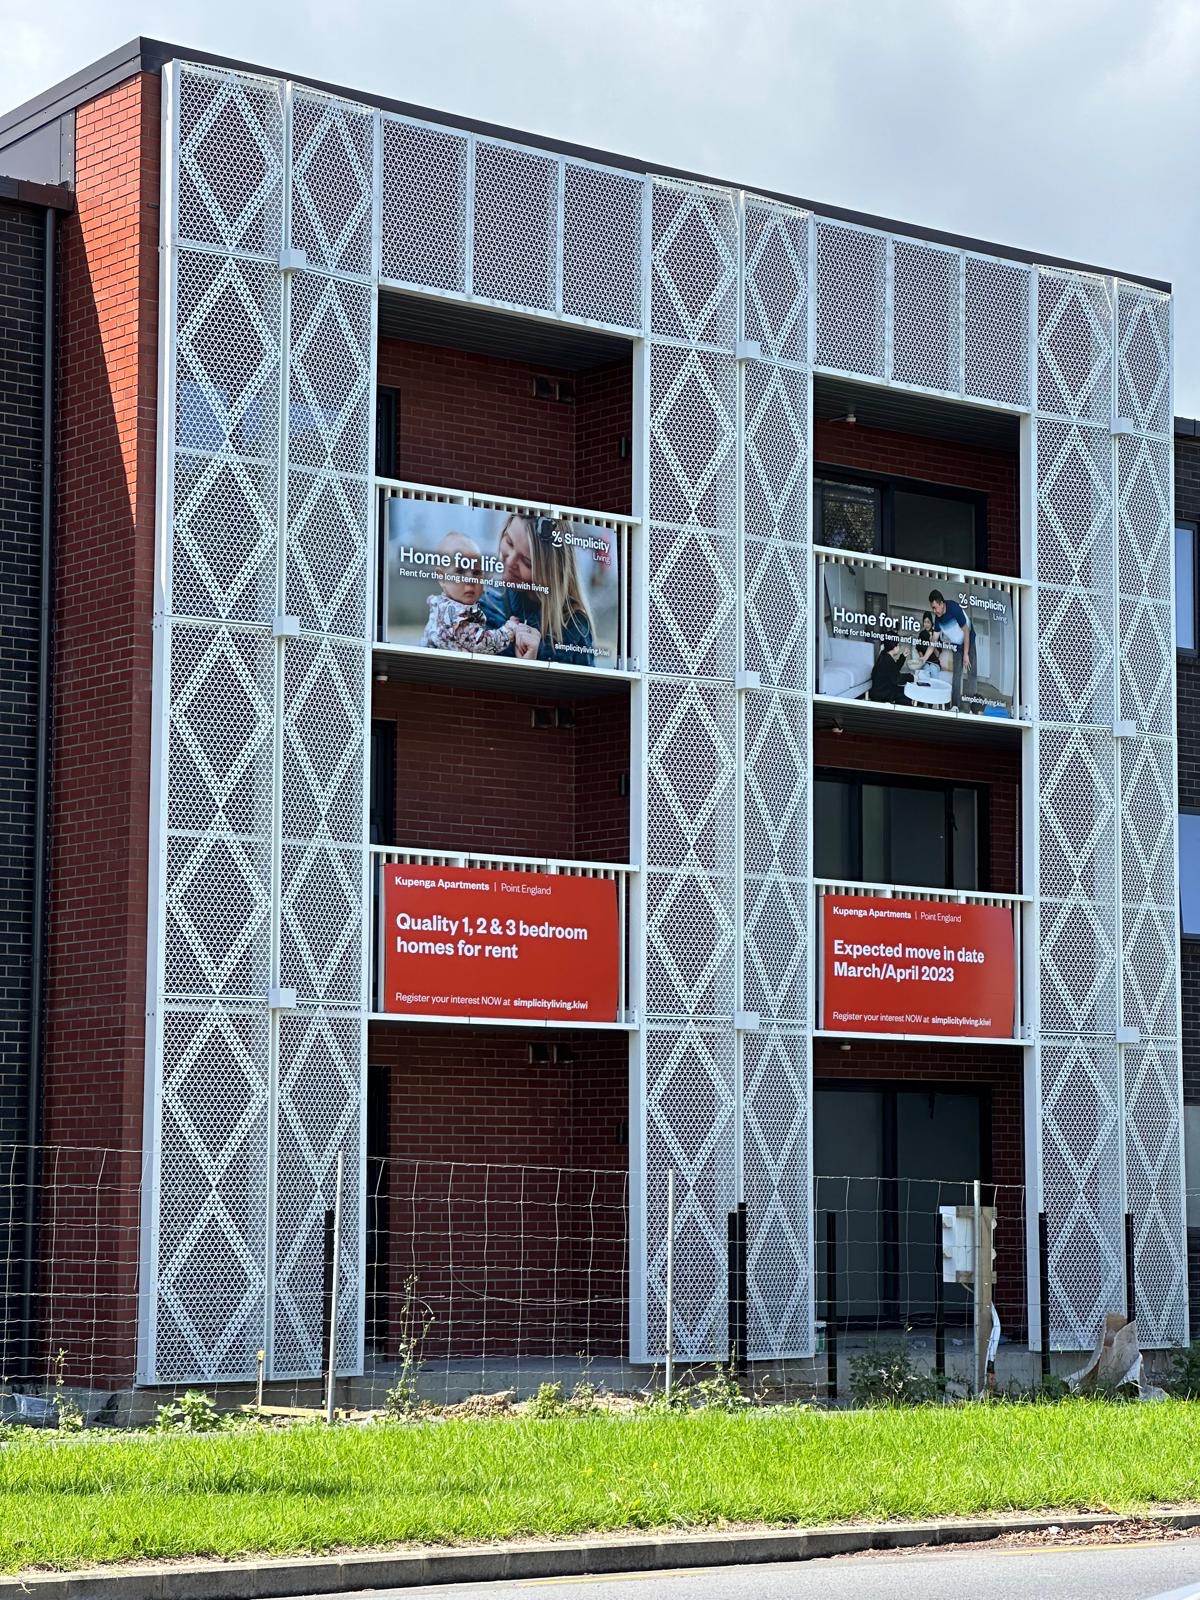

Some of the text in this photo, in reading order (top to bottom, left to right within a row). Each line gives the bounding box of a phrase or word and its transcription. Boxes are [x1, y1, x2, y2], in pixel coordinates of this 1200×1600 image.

[565, 533, 609, 552] Simplicity
[400, 546, 504, 573] Home for life
[593, 552, 611, 564] Living
[400, 568, 417, 577] Rent
[419, 570, 430, 579] for
[431, 571, 443, 580] the
[445, 573, 460, 583] long
[461, 575, 479, 584] term
[480, 577, 493, 586] and
[494, 579, 505, 589] get
[517, 582, 531, 591] with
[532, 583, 549, 594] living
[969, 596, 1006, 613] Simplicity
[834, 607, 920, 631] Home for life
[992, 614, 1007, 624] Living
[833, 627, 849, 635] Rent
[850, 629, 859, 637] for
[860, 630, 870, 638] the
[871, 631, 884, 641] long
[885, 634, 899, 642] term
[900, 636, 911, 644] and
[913, 638, 922, 647] get
[930, 641, 942, 649] with
[942, 642, 957, 651] living
[395, 877, 551, 896] Kupenga Apartments Point England
[833, 907, 961, 923] Kupenga Apartments Point England
[396, 913, 587, 940] Quality 1, 2 & 3 bedroom
[396, 937, 518, 959] homes for rent
[834, 940, 984, 963] Expected move in date
[834, 962, 954, 982] March/April 2023
[396, 993, 588, 1010] Register your interest NOW at simplicityliving.kiwi
[833, 1012, 862, 1023] Register
[864, 1015, 879, 1024] your
[880, 1014, 904, 1023] interest
[905, 1015, 923, 1023] NOW
[932, 1016, 991, 1028] simplicityliving.kiwi
